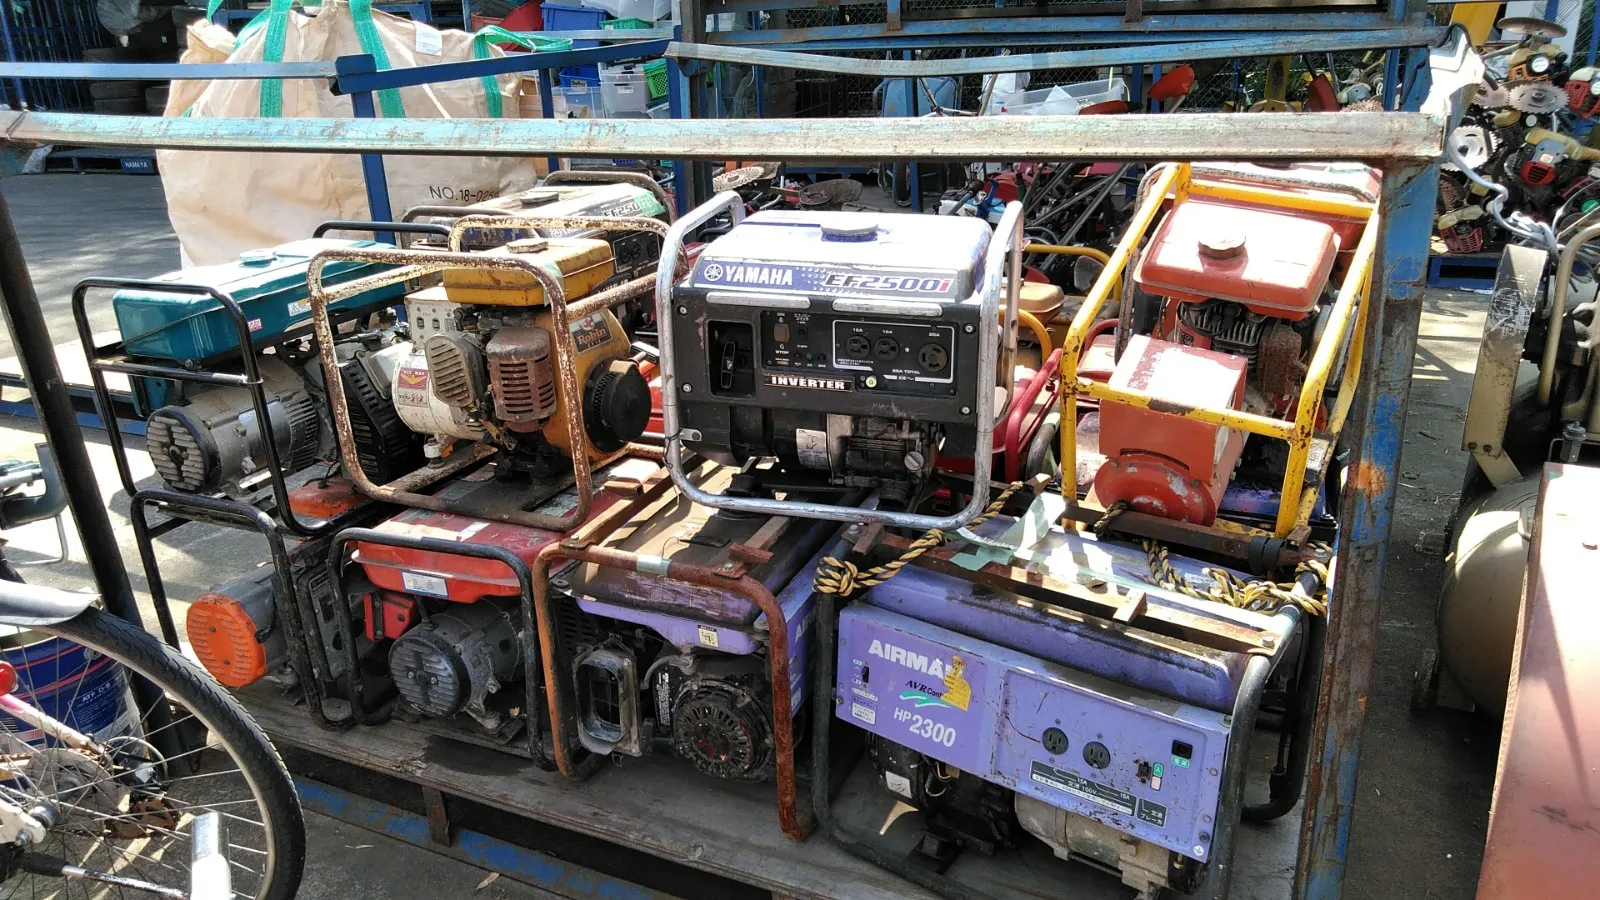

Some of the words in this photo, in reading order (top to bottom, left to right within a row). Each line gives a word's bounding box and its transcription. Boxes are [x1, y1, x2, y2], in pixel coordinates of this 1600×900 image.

[124, 161, 149, 169] HAMAYA
[724, 265, 793, 286] YAMAHA
[823, 272, 954, 294] EF2500i
[577, 328, 605, 345] Robin
[771, 376, 845, 390] INVERTER
[905, 680, 928, 694] AVR
[893, 707, 911, 724] HP
[909, 714, 957, 748] 2300
